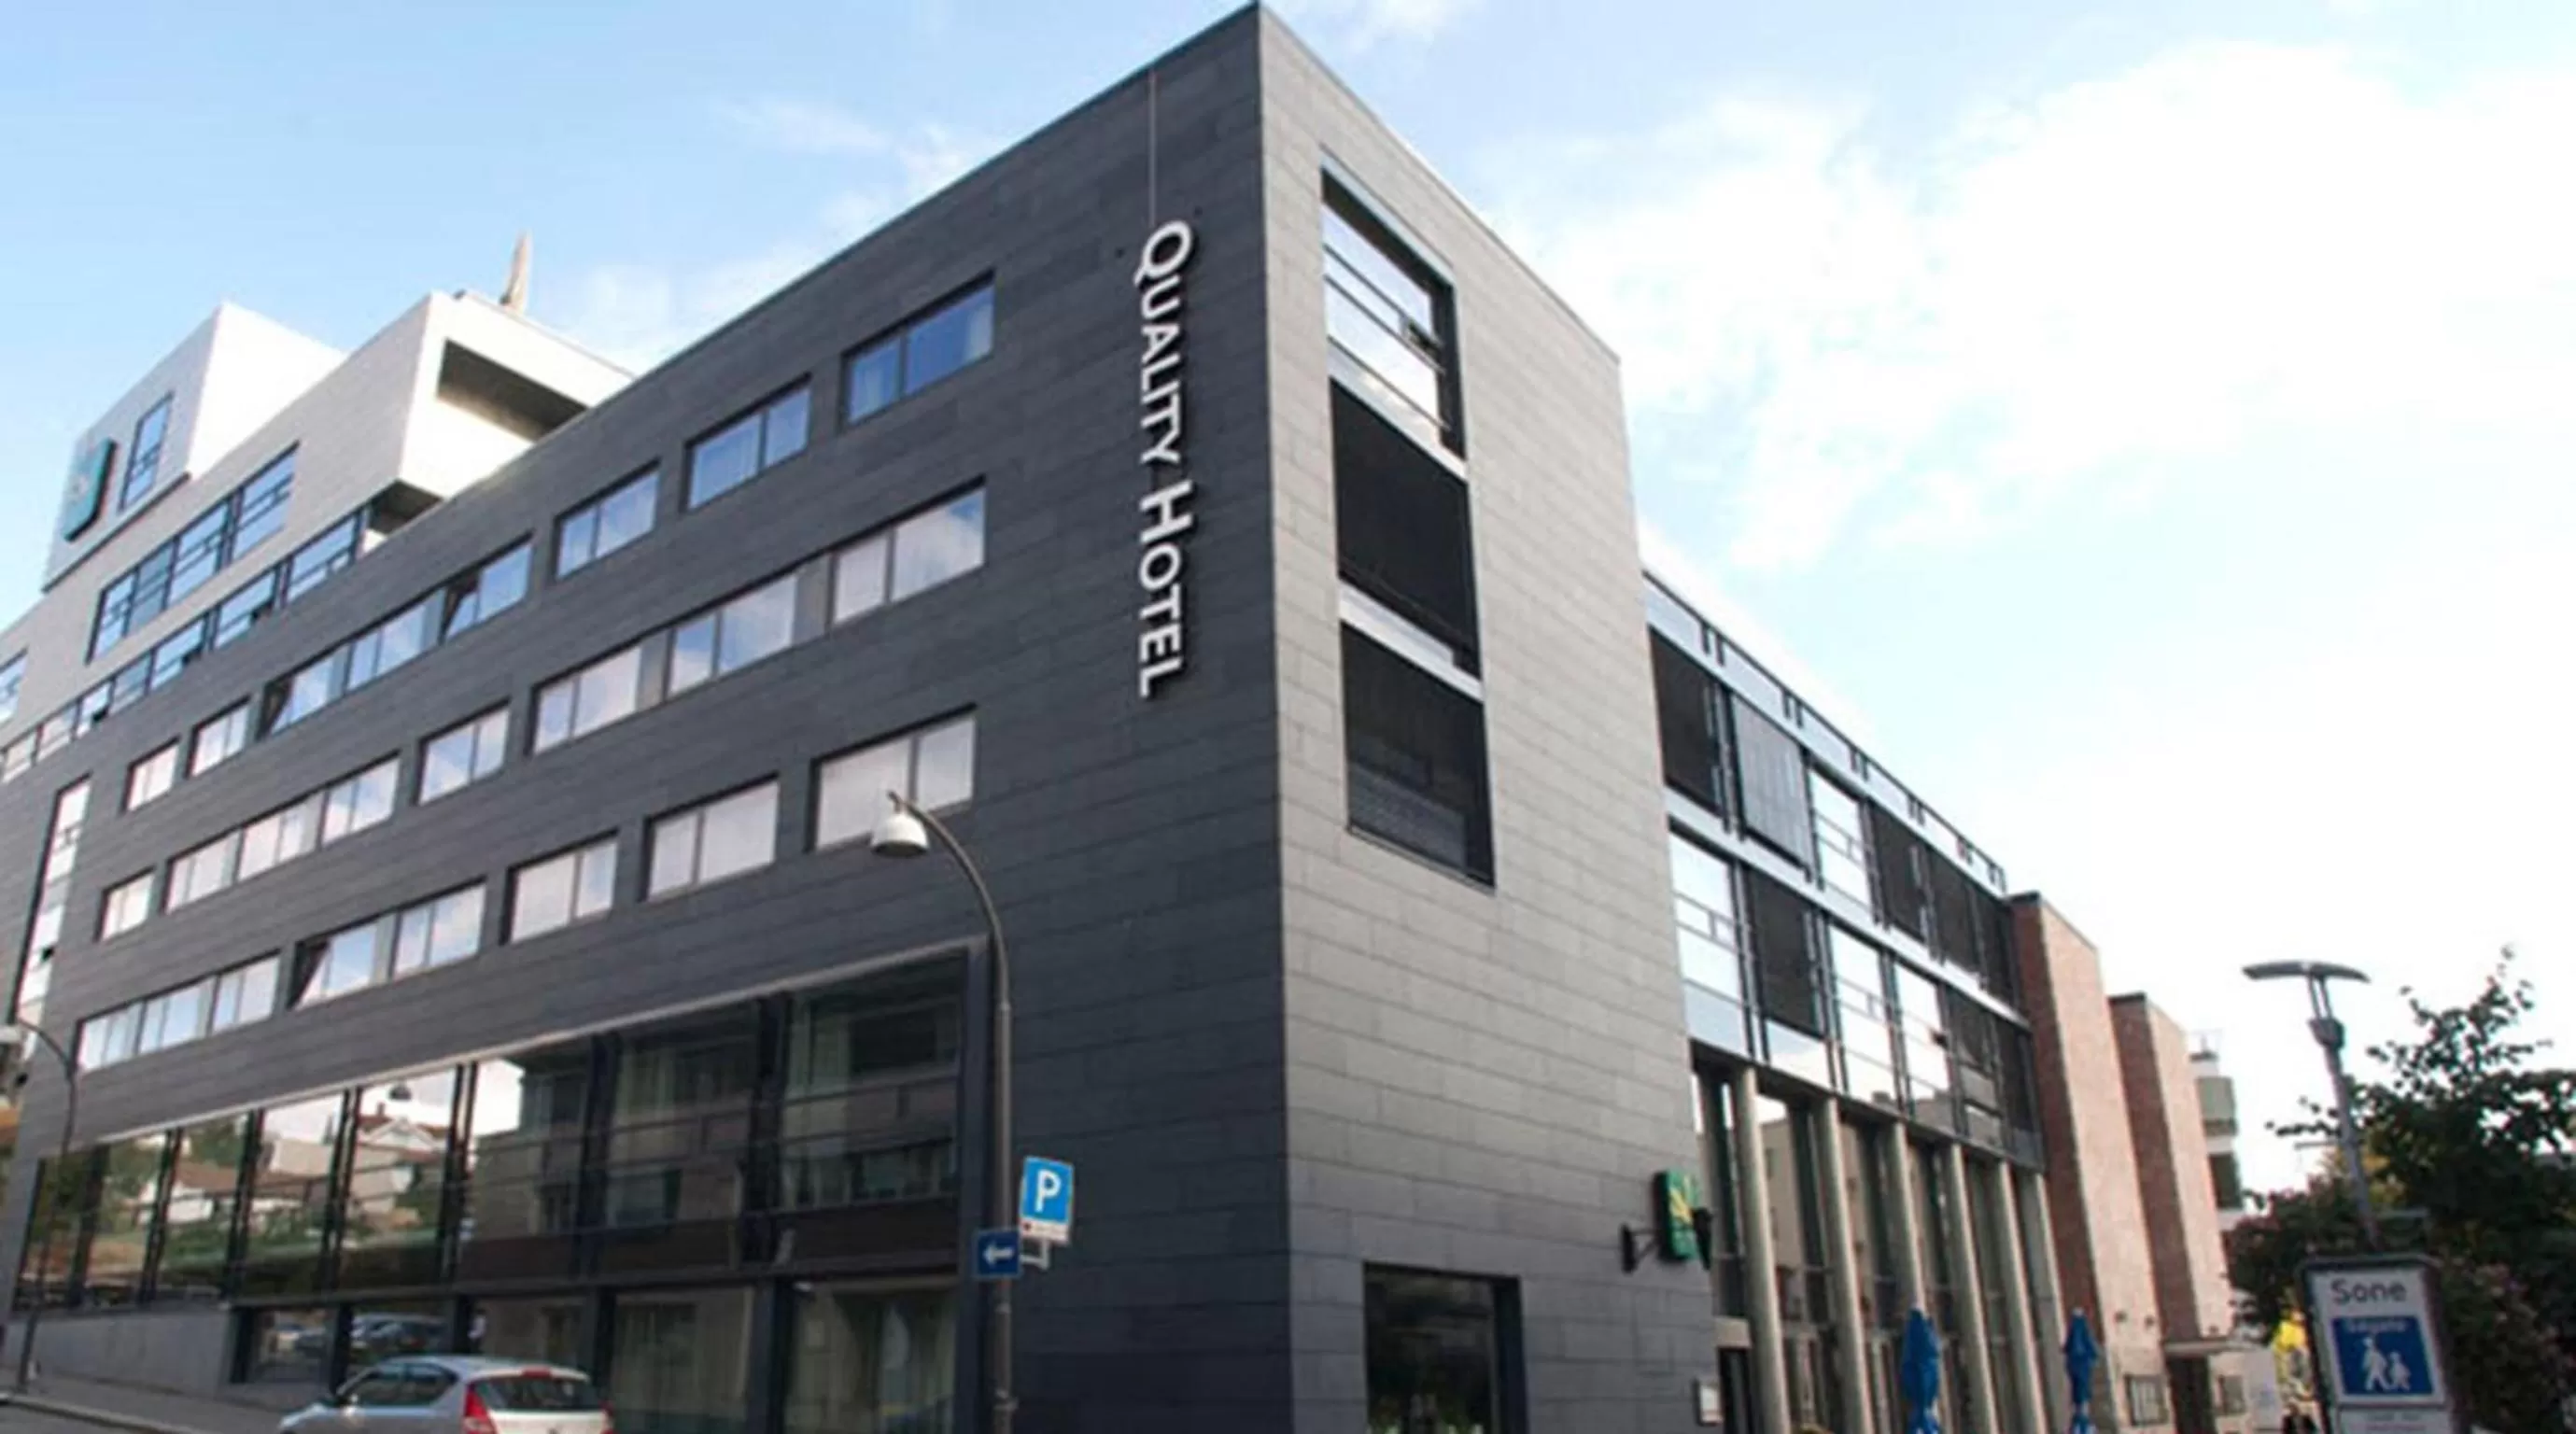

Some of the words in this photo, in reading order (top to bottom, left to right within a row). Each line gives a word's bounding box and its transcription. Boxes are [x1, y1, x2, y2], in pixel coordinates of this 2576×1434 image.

[1133, 220, 1192, 465] QUALITY
[1138, 479, 1194, 698] HOTEL
[1035, 1169, 1062, 1213] P
[2330, 1278, 2407, 1303] Sone
